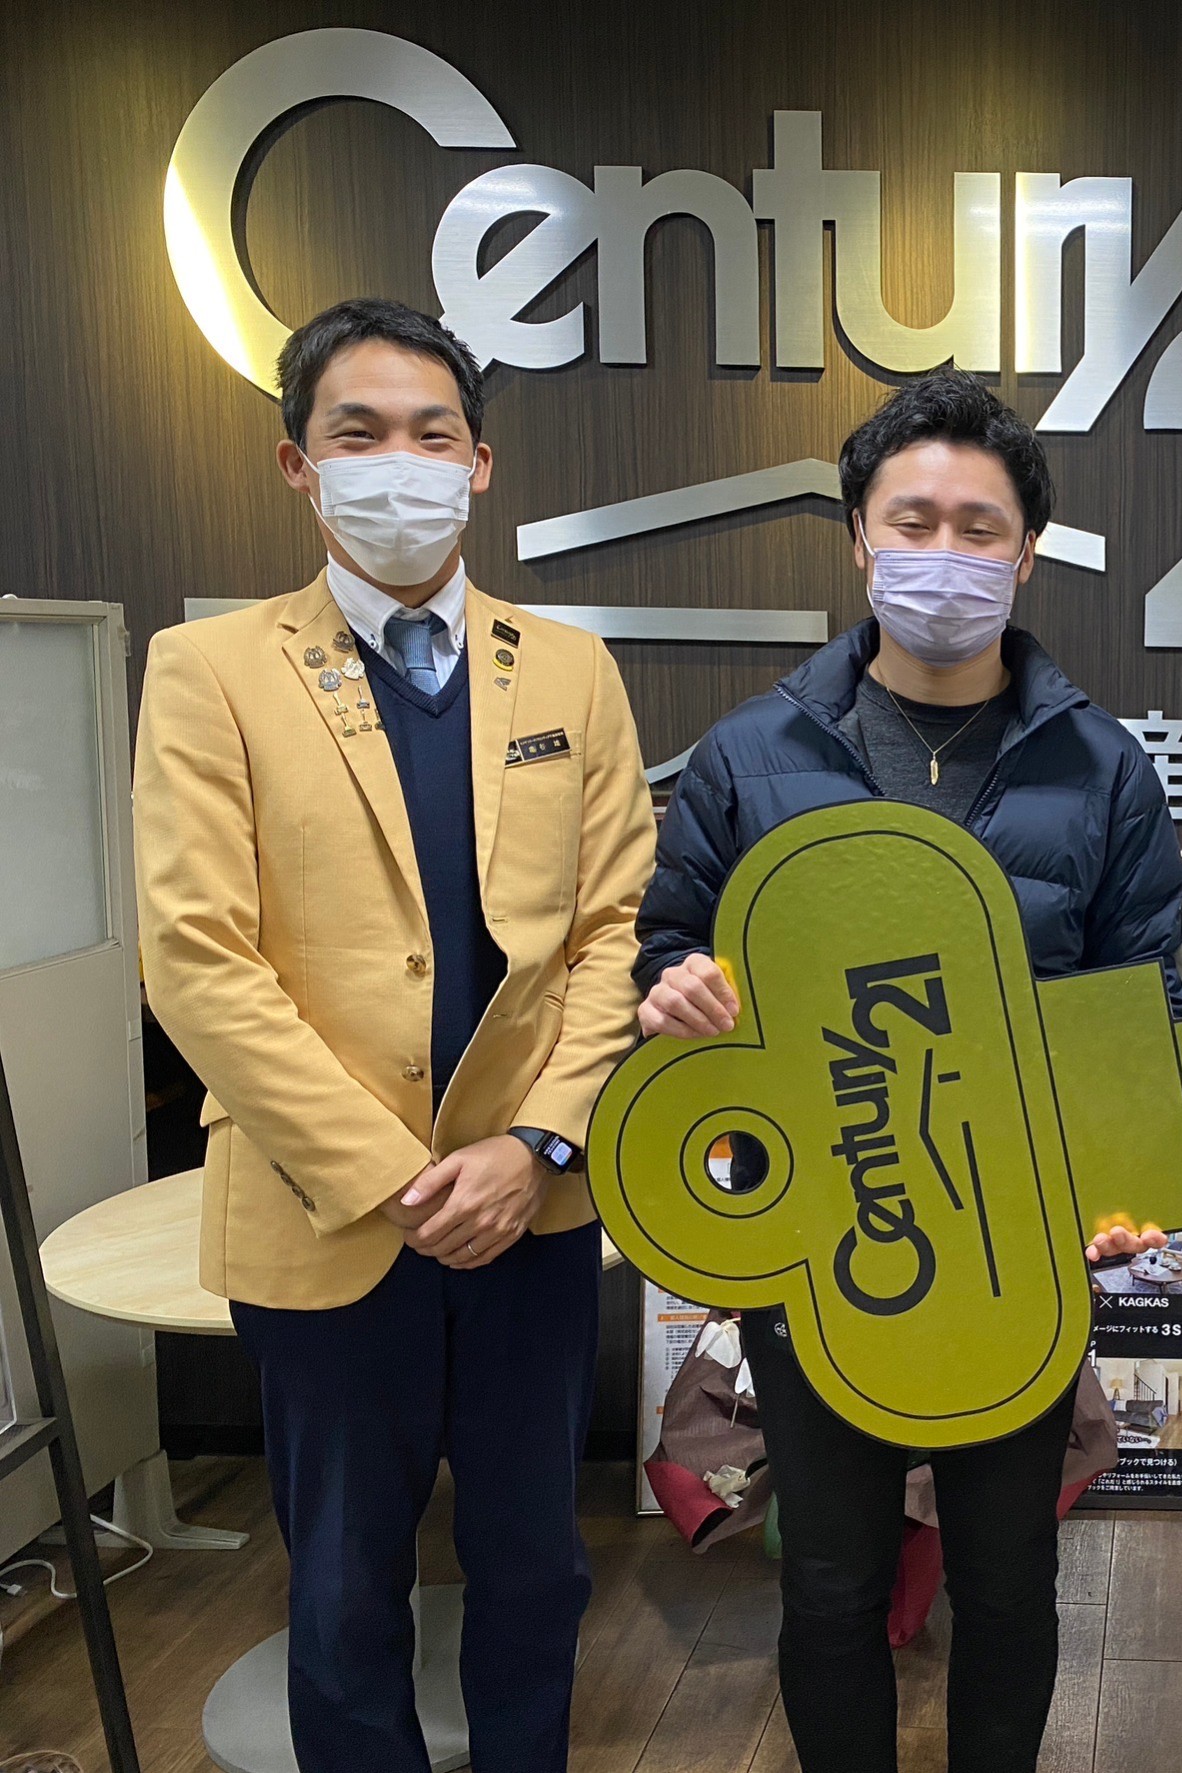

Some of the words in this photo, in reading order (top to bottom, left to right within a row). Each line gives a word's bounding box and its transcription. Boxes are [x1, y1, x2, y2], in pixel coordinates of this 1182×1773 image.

[844, 952, 953, 1048] 21
[820, 1026, 936, 1317] Century
[1118, 1297, 1169, 1308] KAGKAS
